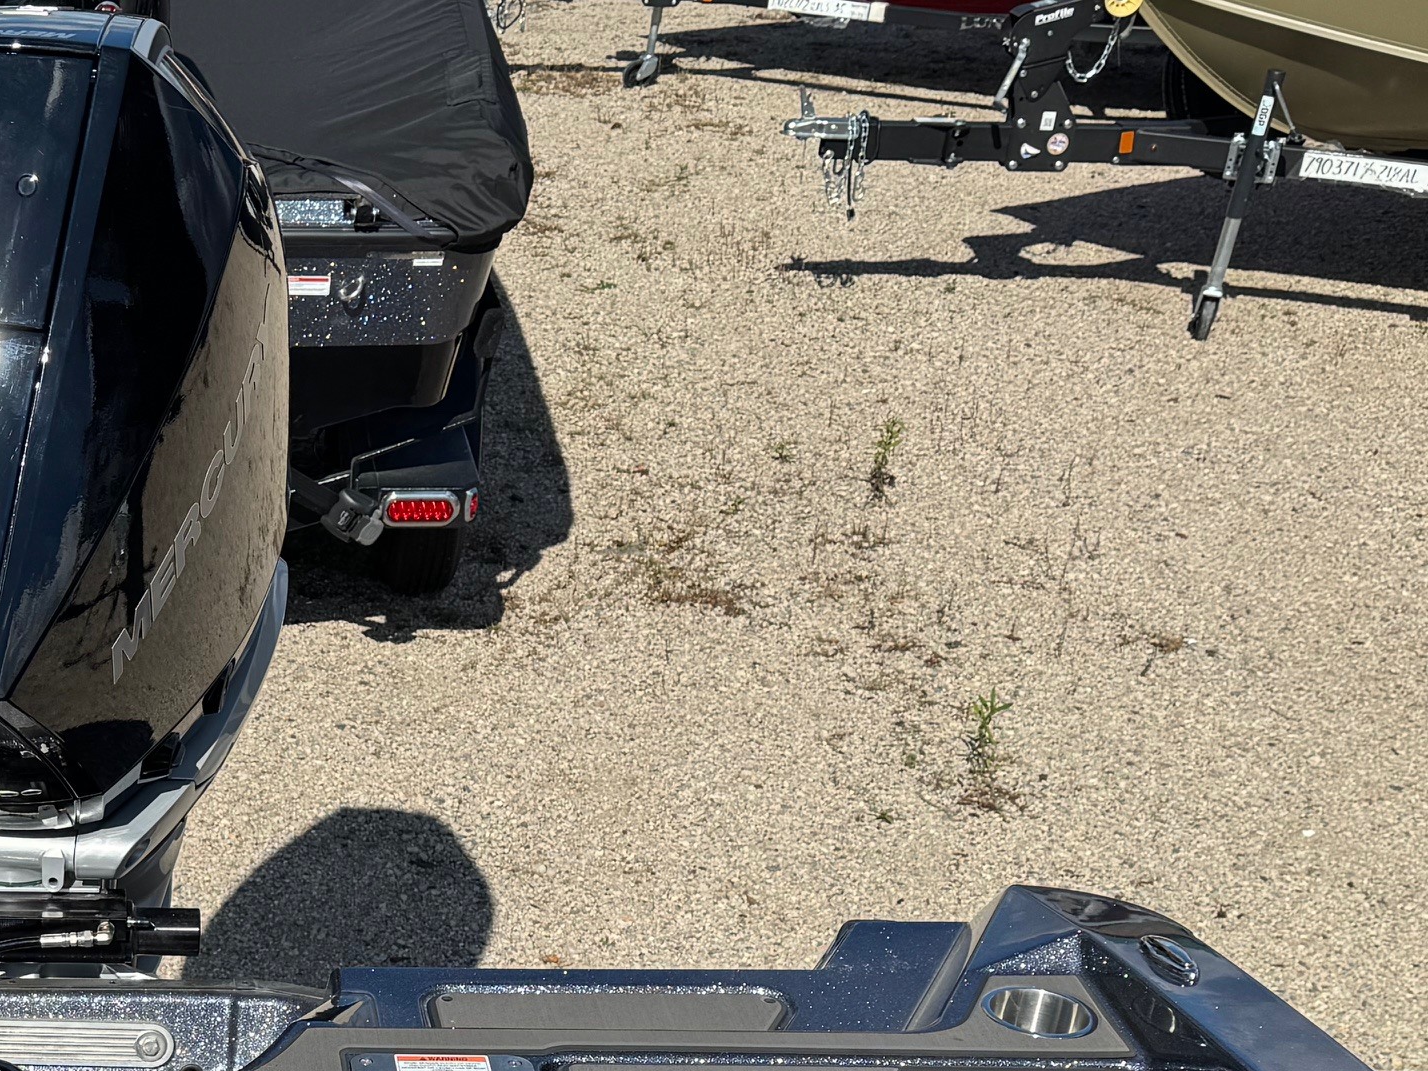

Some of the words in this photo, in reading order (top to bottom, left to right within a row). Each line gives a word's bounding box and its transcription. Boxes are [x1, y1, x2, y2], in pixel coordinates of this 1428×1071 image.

[960, 16, 1007, 31] LUN
[1034, 7, 1075, 27] Profile
[111, 282, 271, 685] MERCURY
